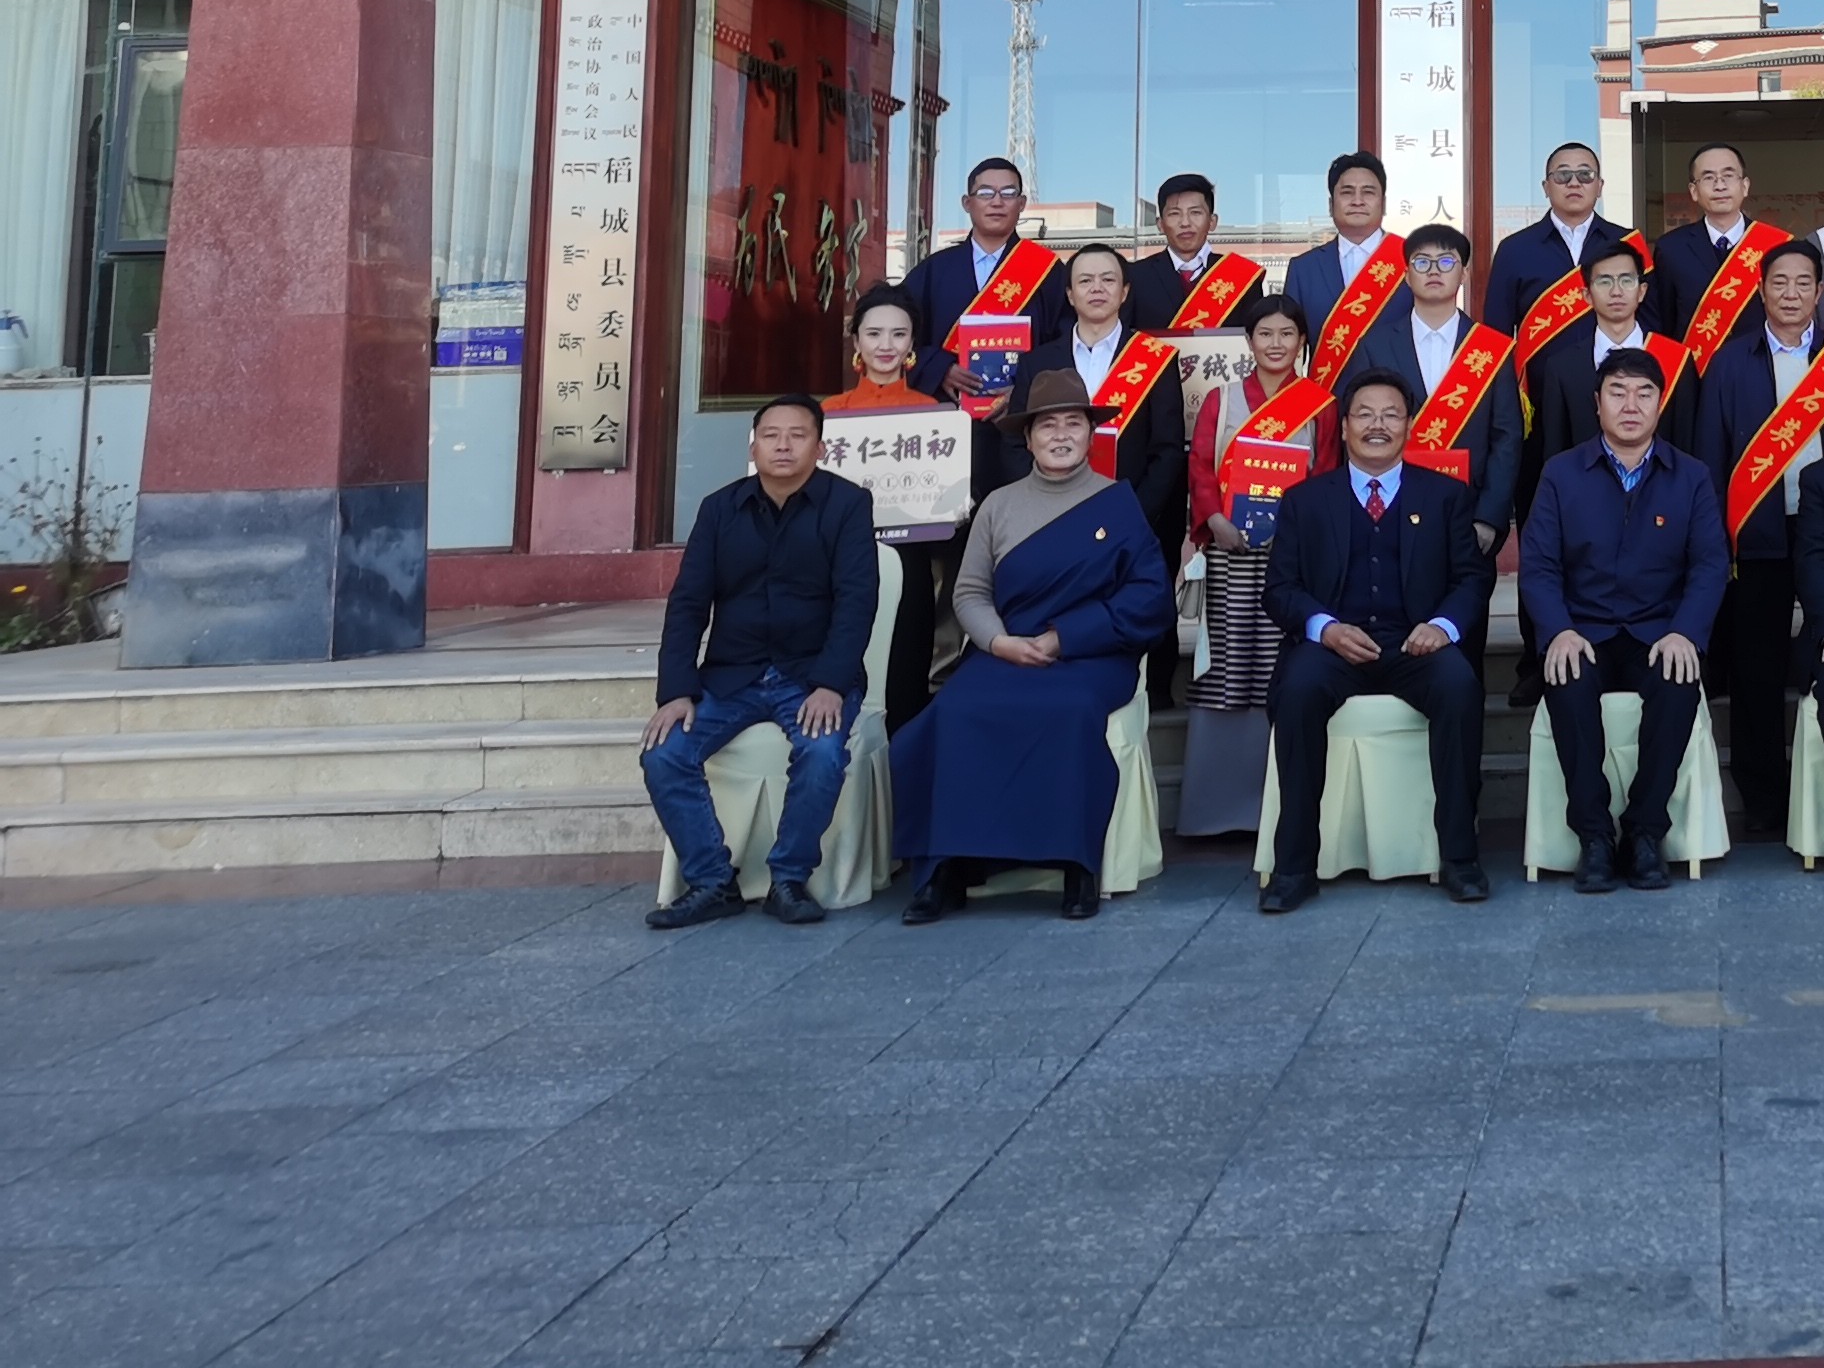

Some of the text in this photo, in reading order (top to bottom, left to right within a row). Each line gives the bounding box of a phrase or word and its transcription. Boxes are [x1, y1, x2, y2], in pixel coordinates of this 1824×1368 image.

[584, 14, 602, 140] 政治协商会议
[623, 13, 642, 139] 中国人民
[1427, 1, 1456, 222] 稻城县人
[590, 157, 632, 444] 稻城县委员会
[1314, 260, 1397, 385] 璞石英才
[1529, 287, 1584, 340] 英才
[822, 429, 957, 468] 泽仁拥初
[1416, 347, 1493, 451] 璞石英
